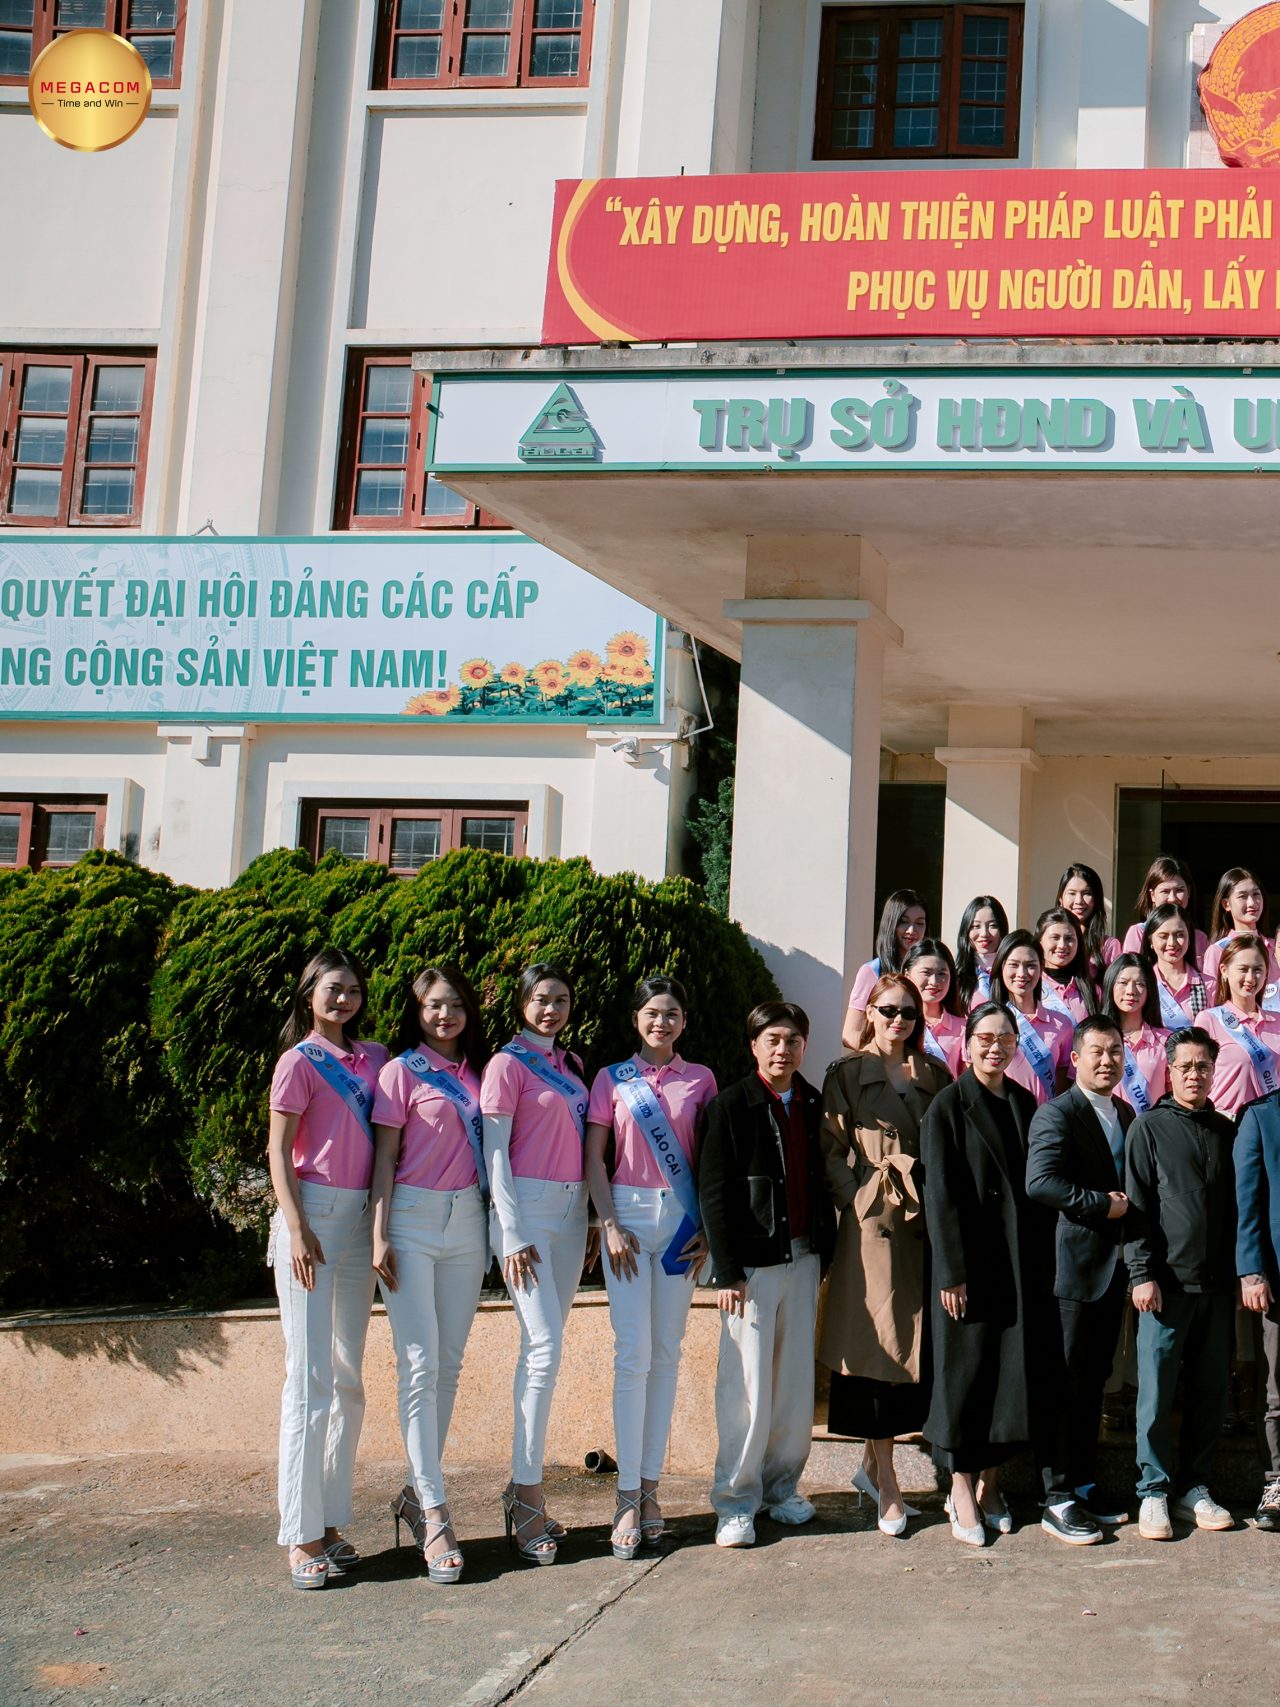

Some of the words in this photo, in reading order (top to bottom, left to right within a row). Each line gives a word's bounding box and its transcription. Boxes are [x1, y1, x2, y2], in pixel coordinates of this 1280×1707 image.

[606, 196, 683, 246] “XÂY
[692, 199, 789, 253] DỰNG,
[799, 193, 890, 242] HOÀN
[901, 193, 994, 249] THIỆN
[1004, 191, 1093, 240] PHÁP
[1103, 190, 1185, 248] LUẬT
[1194, 185, 1273, 239] PHẢI
[847, 269, 936, 320] PHỤC
[947, 269, 988, 320] VỤ
[998, 259, 1102, 310] NGƯỜI
[1112, 261, 1193, 315] DÂN,
[1203, 254, 1265, 310] LẤY
[692, 398, 808, 458] TRỤ
[830, 379, 916, 448] SỞ
[937, 397, 1108, 449] HĐND
[1132, 385, 1207, 449] VÀ
[1, 567, 113, 621] QUYẾT
[126, 579, 186, 627] ĐẠI
[198, 571, 257, 627] HỘI
[270, 567, 367, 619] ĐẢNG
[382, 572, 453, 619] CÁC
[467, 566, 539, 619] CẤP
[1, 647, 51, 687] NG
[65, 639, 162, 696] CỘNG
[176, 635, 252, 688] SẢN
[264, 641, 338, 697] VIỆT
[350, 649, 448, 689] NAM!
[411, 1056, 426, 1069] 115
[618, 1066, 635, 1077] 214
[650, 1126, 670, 1152] LÀO
[665, 1153, 682, 1176] CAI
